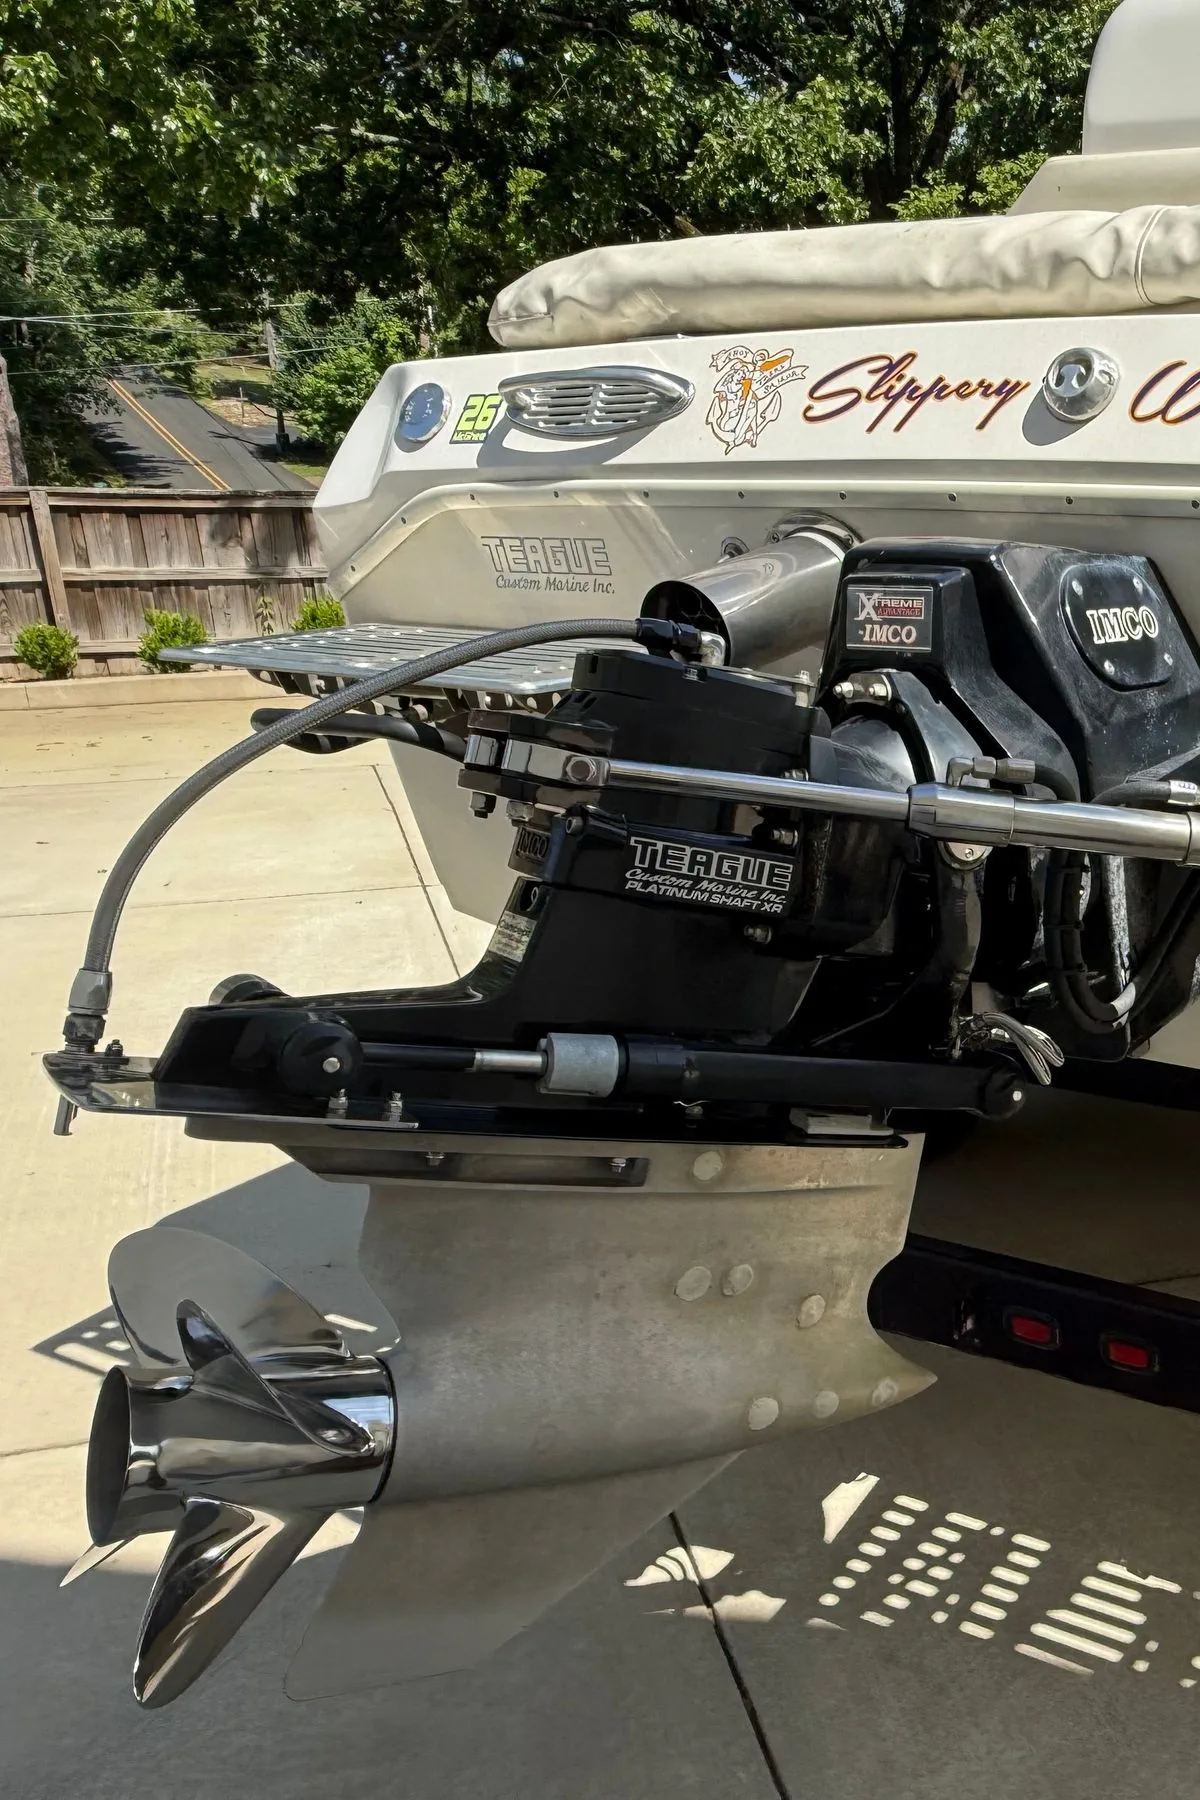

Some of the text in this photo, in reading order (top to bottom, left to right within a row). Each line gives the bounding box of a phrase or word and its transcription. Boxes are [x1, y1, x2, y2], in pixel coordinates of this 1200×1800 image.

[802, 350, 1031, 434] Slippery
[456, 393, 502, 431] 26
[480, 536, 612, 576] TEAGUE
[496, 575, 616, 594] Custom Marine Inc.
[862, 624, 917, 644] IMCO
[1085, 605, 1159, 645] IMCO
[630, 837, 793, 891] TEAGUE
[625, 868, 787, 904] Custom Marine Inc.
[625, 880, 783, 914] PLATINUM SHAFT XR
